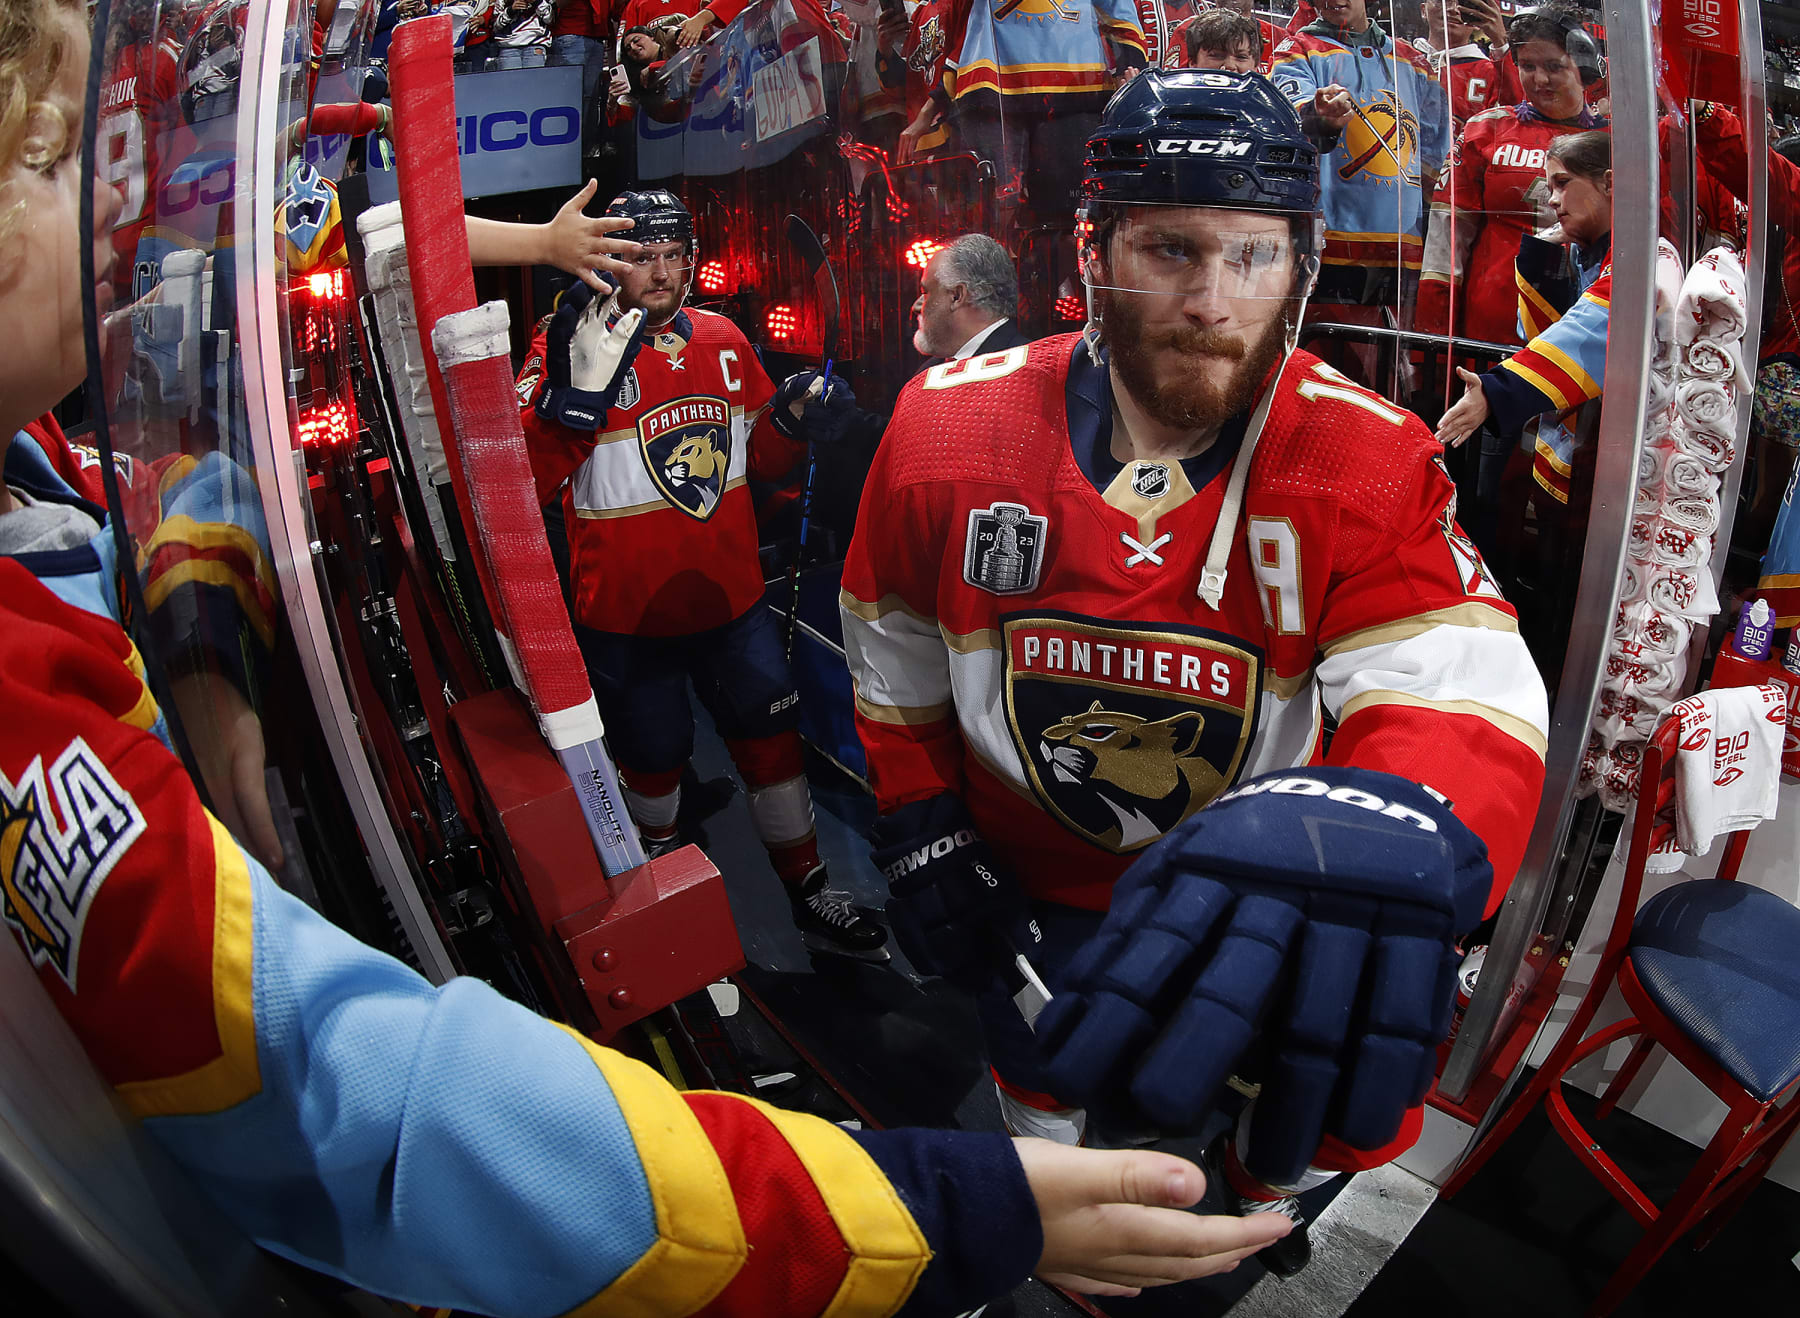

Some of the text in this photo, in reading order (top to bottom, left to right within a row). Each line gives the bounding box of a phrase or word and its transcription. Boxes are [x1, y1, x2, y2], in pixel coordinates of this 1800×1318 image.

[1683, 11, 1720, 24] STEEL
[1467, 78, 1487, 102] C
[1156, 138, 1252, 157] CCM
[1492, 144, 1547, 170] HUB
[719, 349, 741, 393] C
[649, 404, 723, 435] PANTHERS
[1139, 470, 1164, 491] NHL
[979, 532, 1034, 547] 20 23
[1247, 514, 1306, 636] A
[1742, 637, 1765, 648] STEEL
[1744, 626, 1767, 641] BIO
[1023, 636, 1231, 697] PANTHERS
[1672, 697, 1705, 719] BIO
[1680, 711, 1712, 733] STEEL
[1716, 731, 1750, 757] BIO
[1714, 752, 1747, 770] STEEL
[578, 771, 618, 848] SHIELD
[590, 769, 626, 845] NANOLITE
[11, 753, 134, 961] FLA
